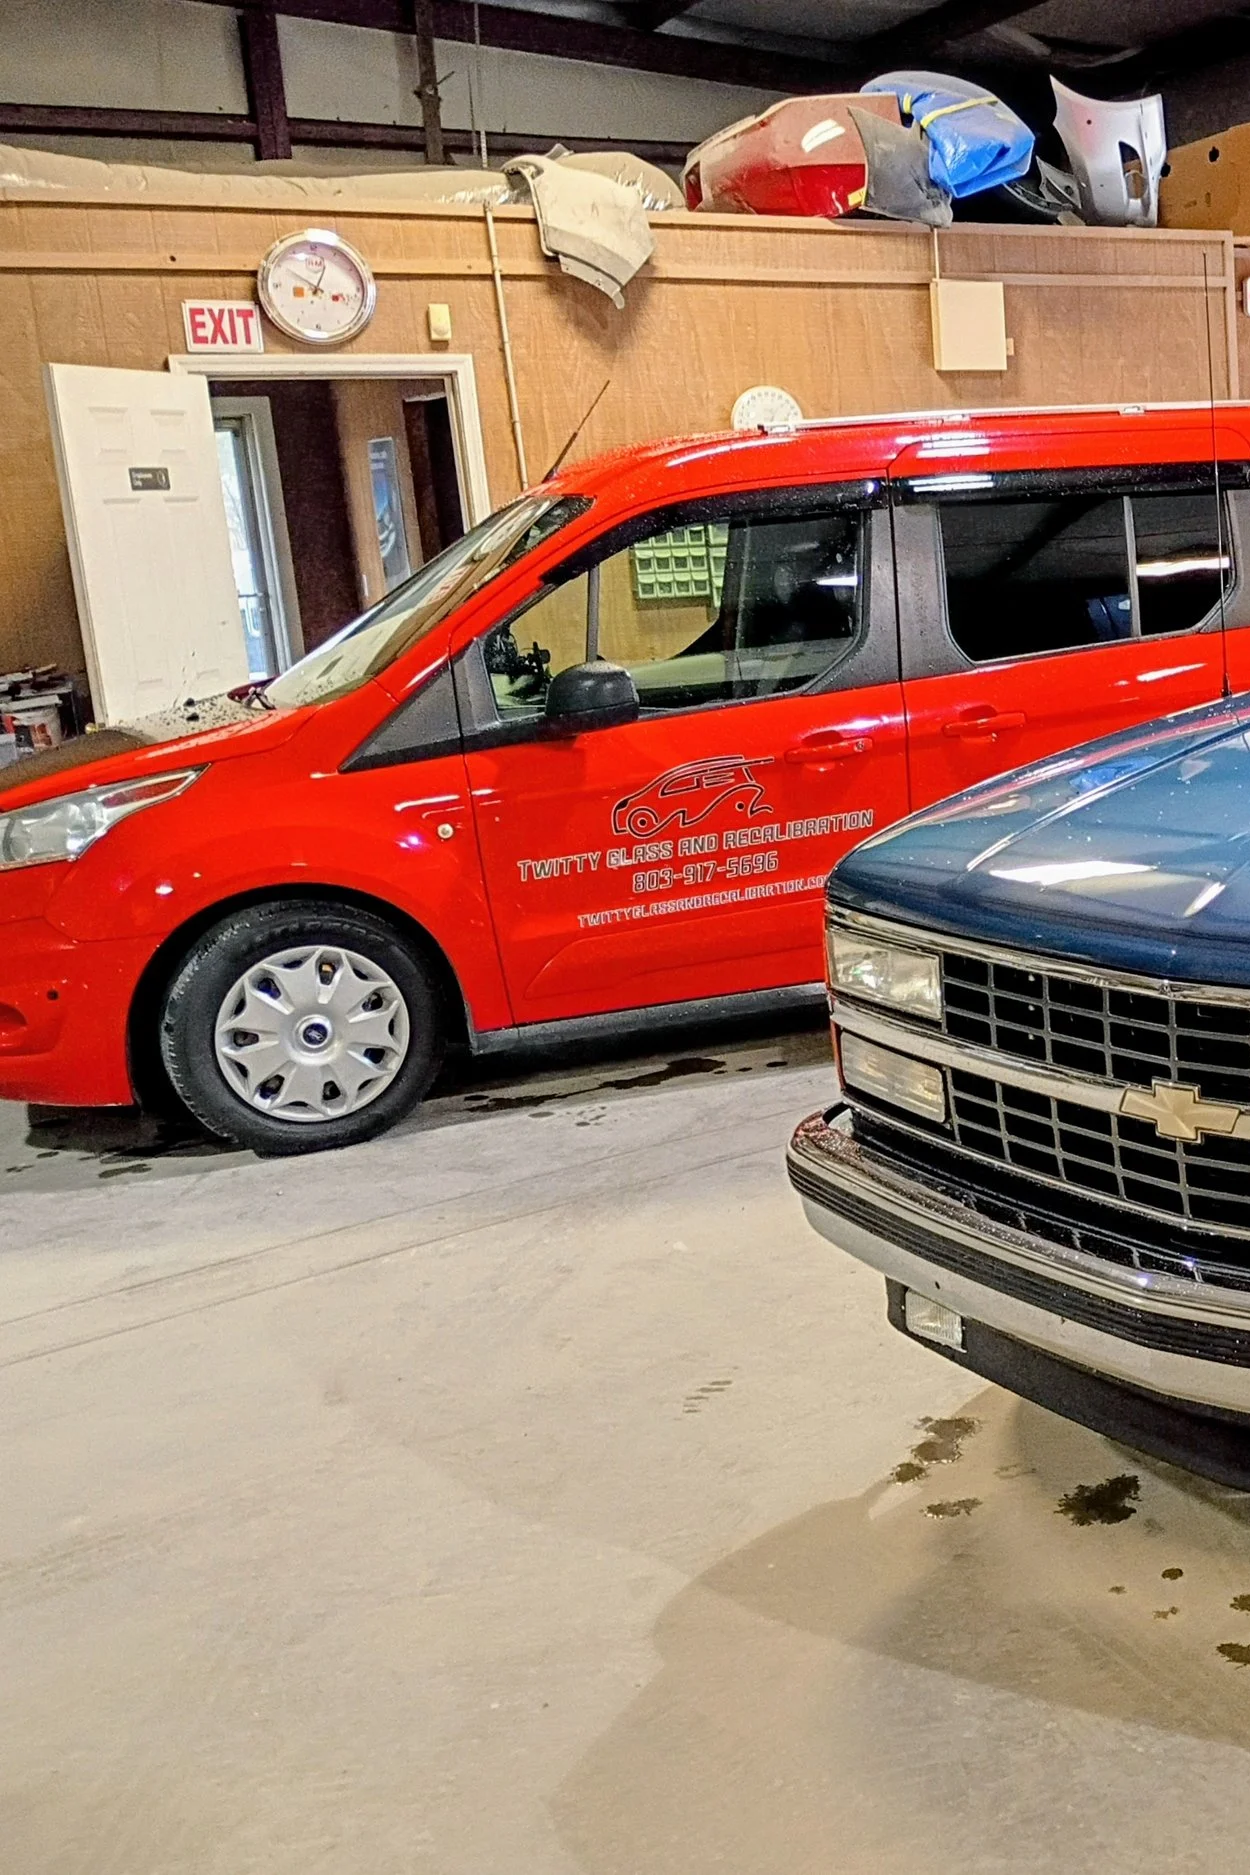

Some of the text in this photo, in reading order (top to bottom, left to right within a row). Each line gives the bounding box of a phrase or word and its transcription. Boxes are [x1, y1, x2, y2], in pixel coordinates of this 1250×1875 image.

[188, 307, 254, 345] EXIT
[517, 809, 874, 881] TWITTY GLASS AND RECALIBRATION
[632, 851, 779, 893] 803-917-5696
[577, 874, 828, 928] TWITTYGLASSANDRECALIBRATION.CO
